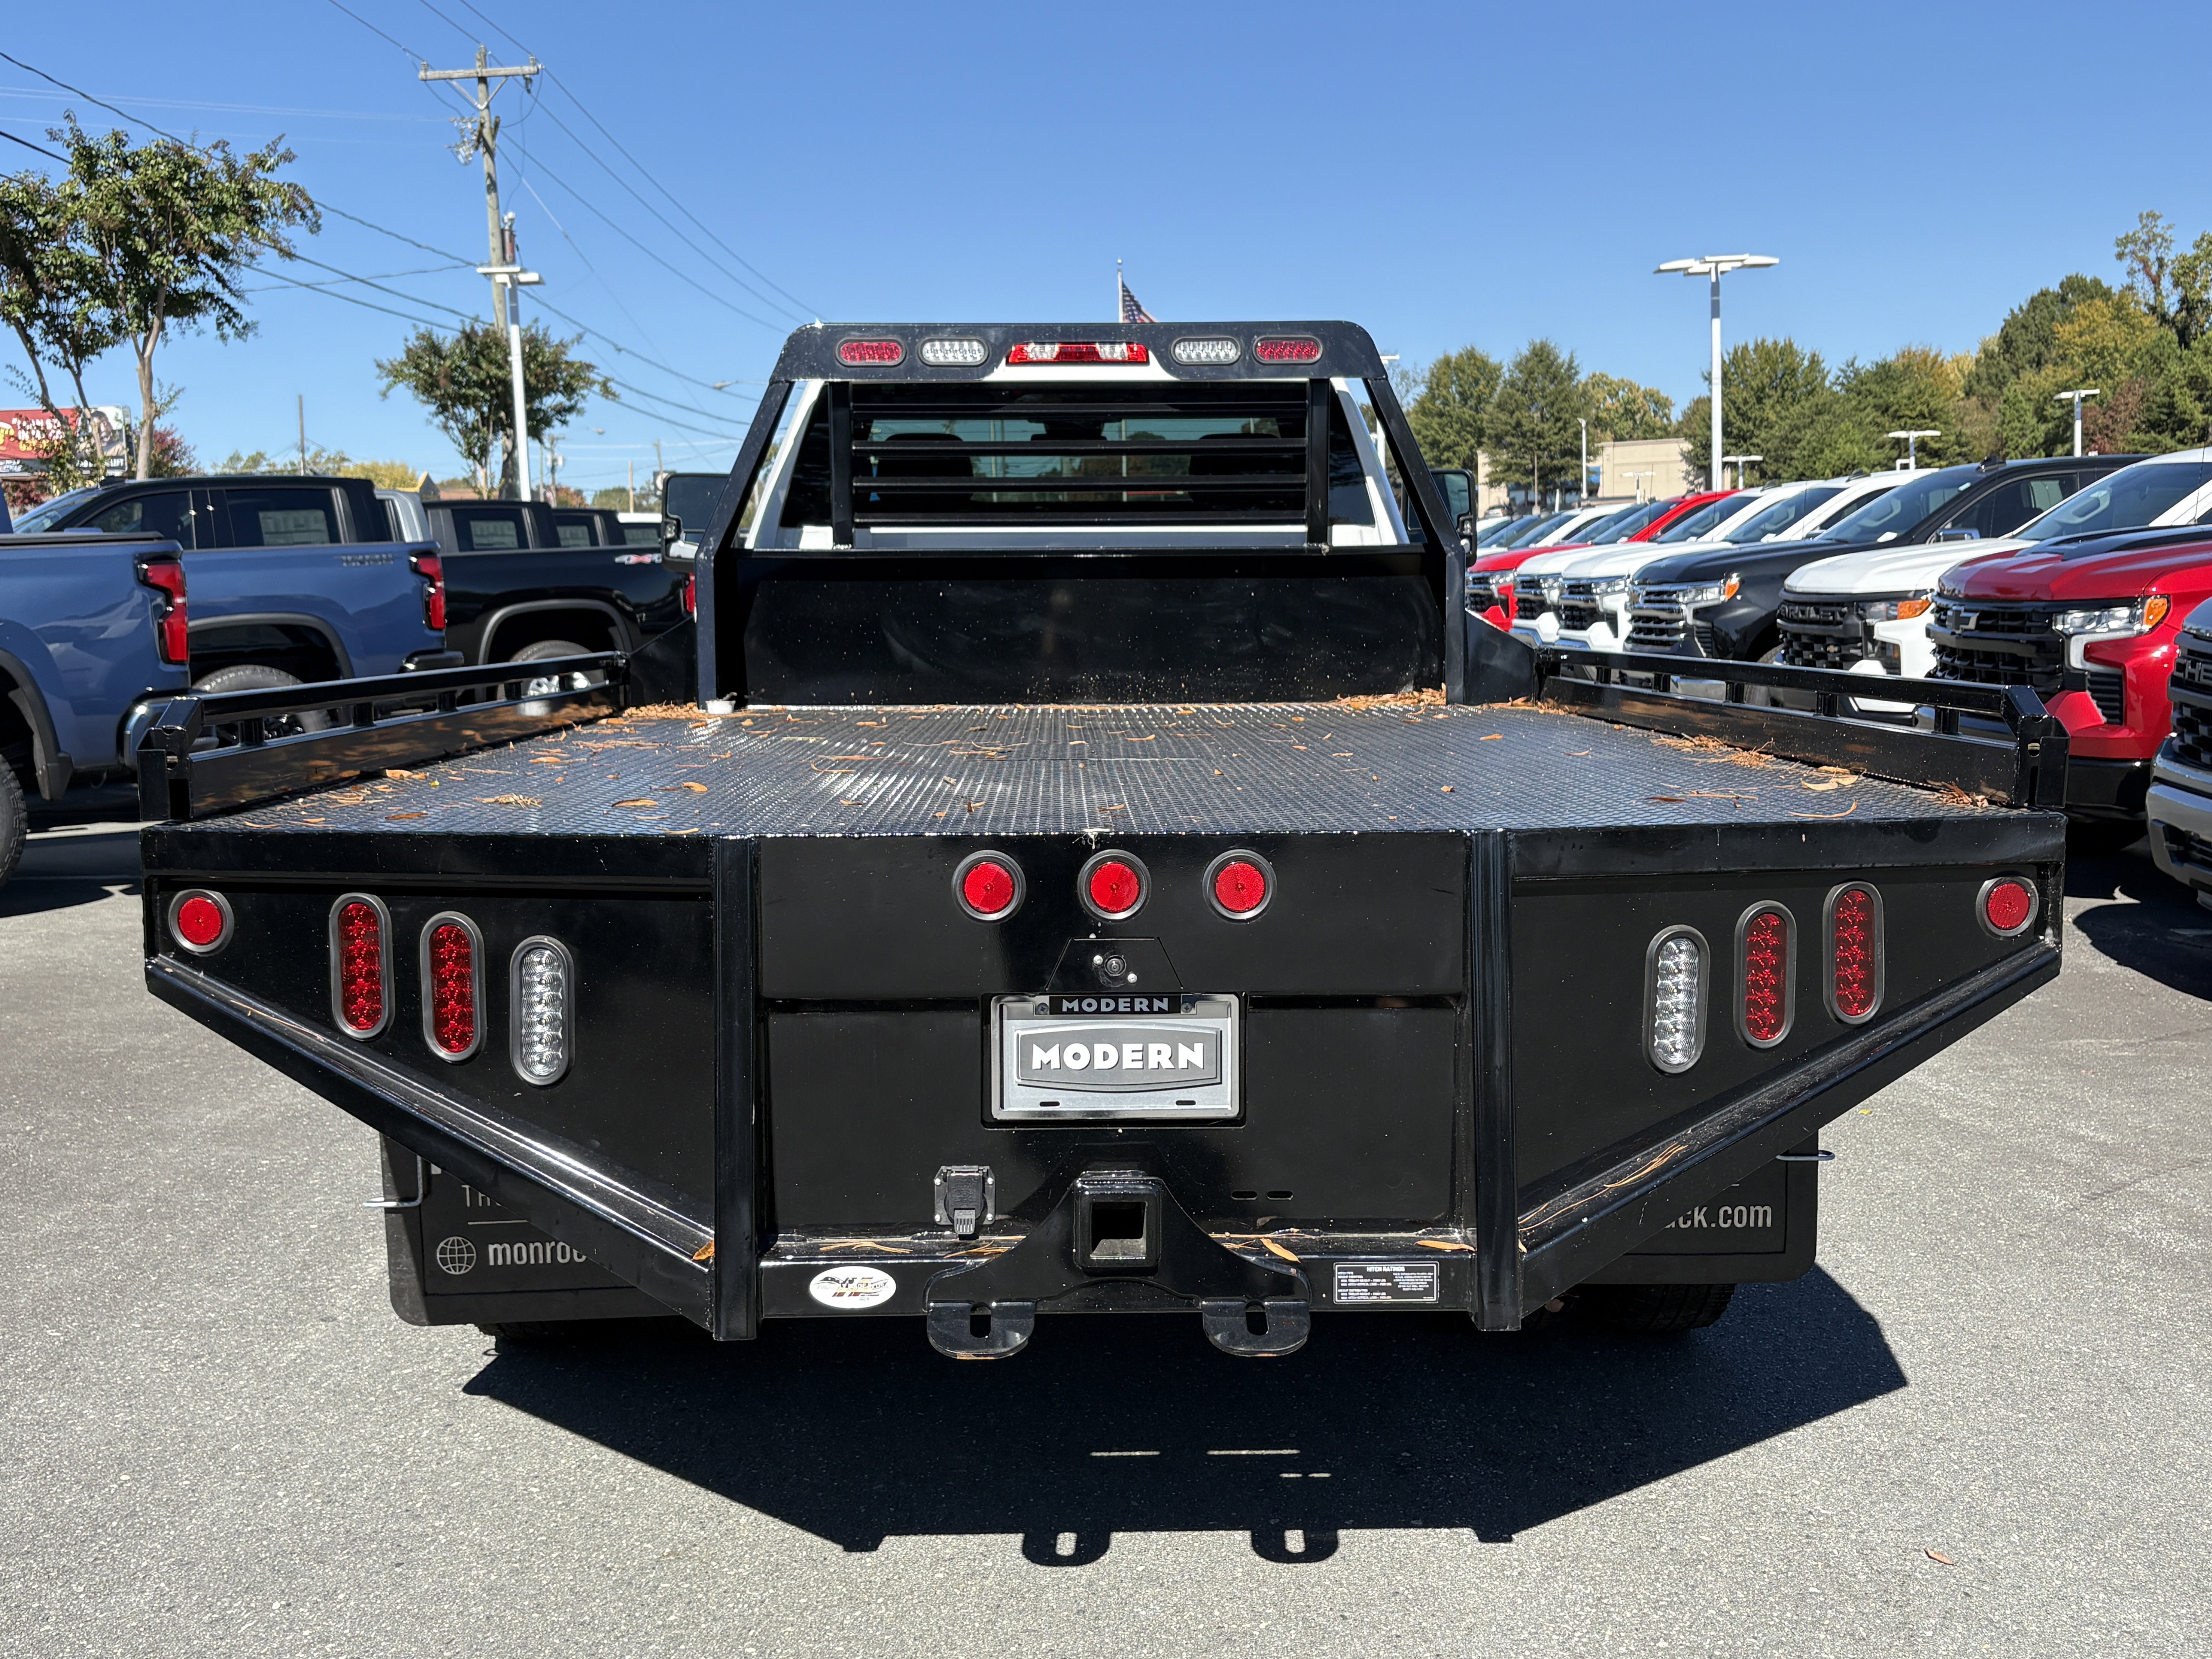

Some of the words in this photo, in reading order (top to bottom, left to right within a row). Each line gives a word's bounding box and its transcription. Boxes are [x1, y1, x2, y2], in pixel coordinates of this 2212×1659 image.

[1062, 998, 1169, 1012] MODERN
[1032, 1042, 1204, 1070] MODERN
[1665, 1206, 1772, 1228] ck.com
